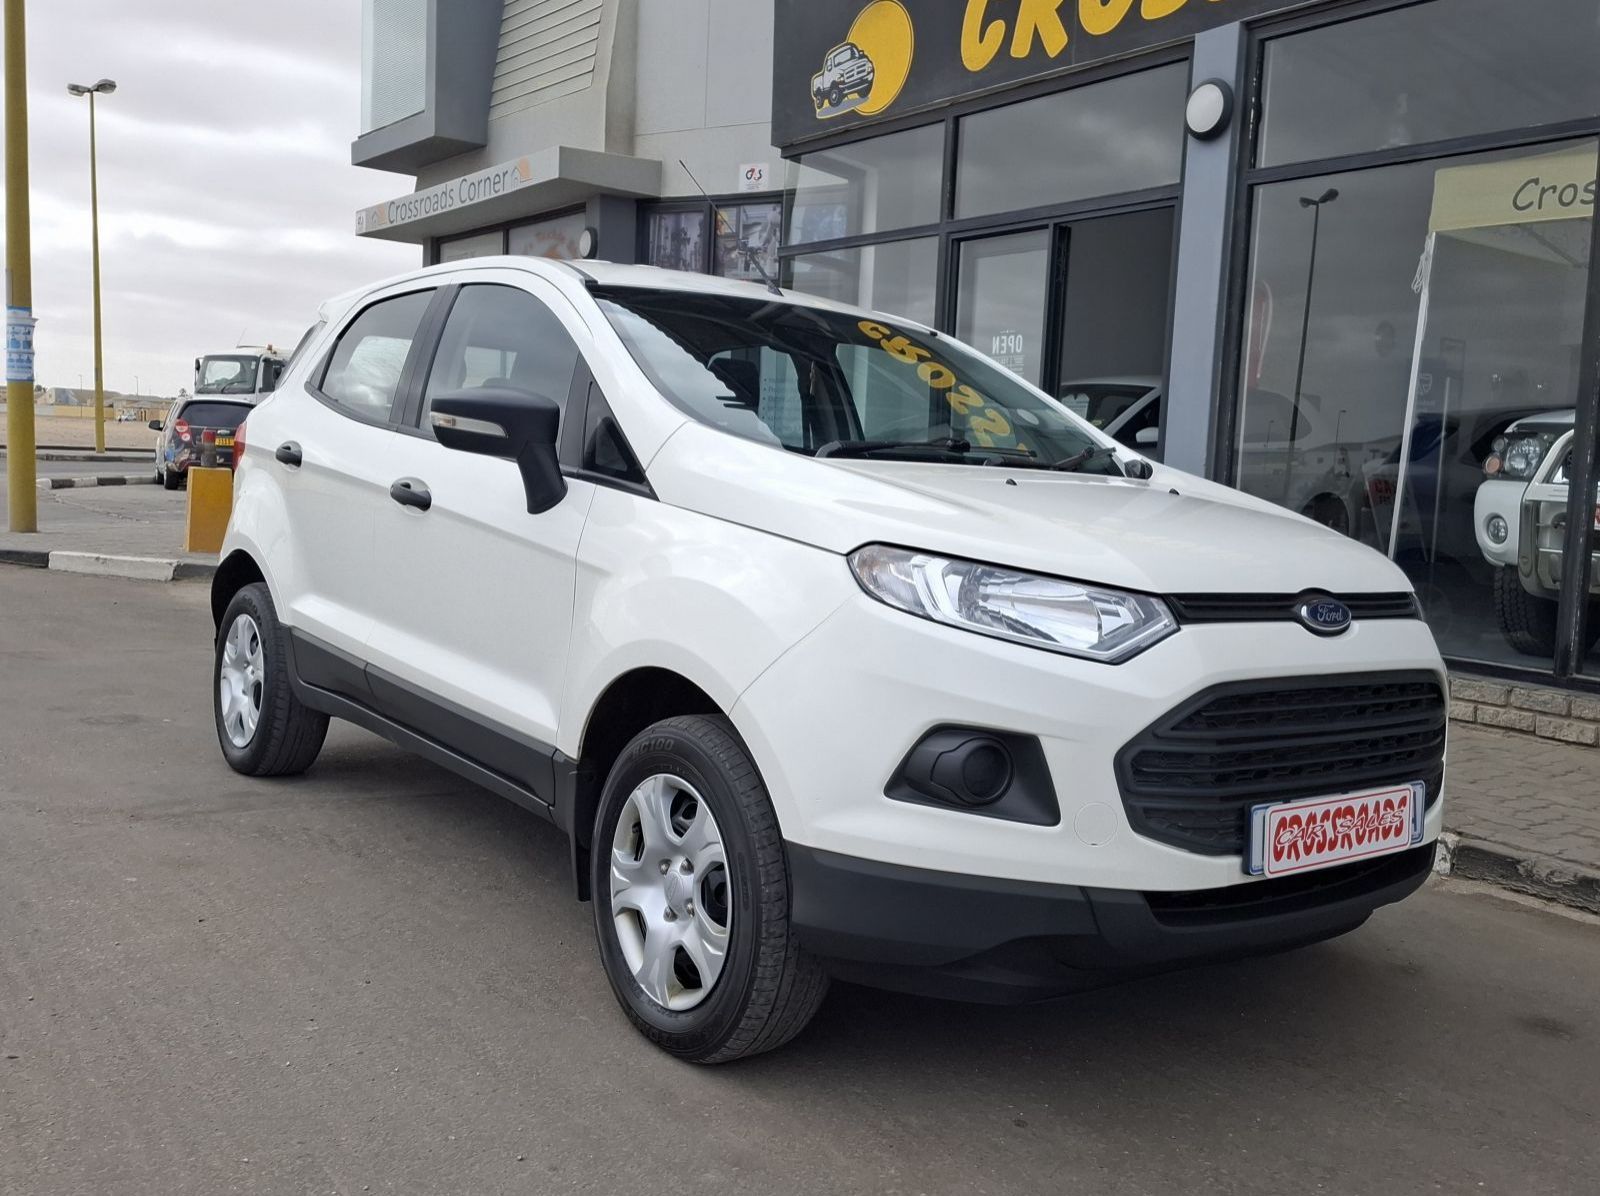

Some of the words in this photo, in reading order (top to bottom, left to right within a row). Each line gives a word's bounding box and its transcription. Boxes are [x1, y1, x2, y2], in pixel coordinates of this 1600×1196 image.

[387, 184, 454, 224] Crossroads
[458, 165, 508, 204] Corner
[1317, 603, 1343, 621] Ford
[1272, 795, 1407, 862] CROSSROADS
[1276, 823, 1325, 847] CAR
[1337, 809, 1404, 834] SALES
